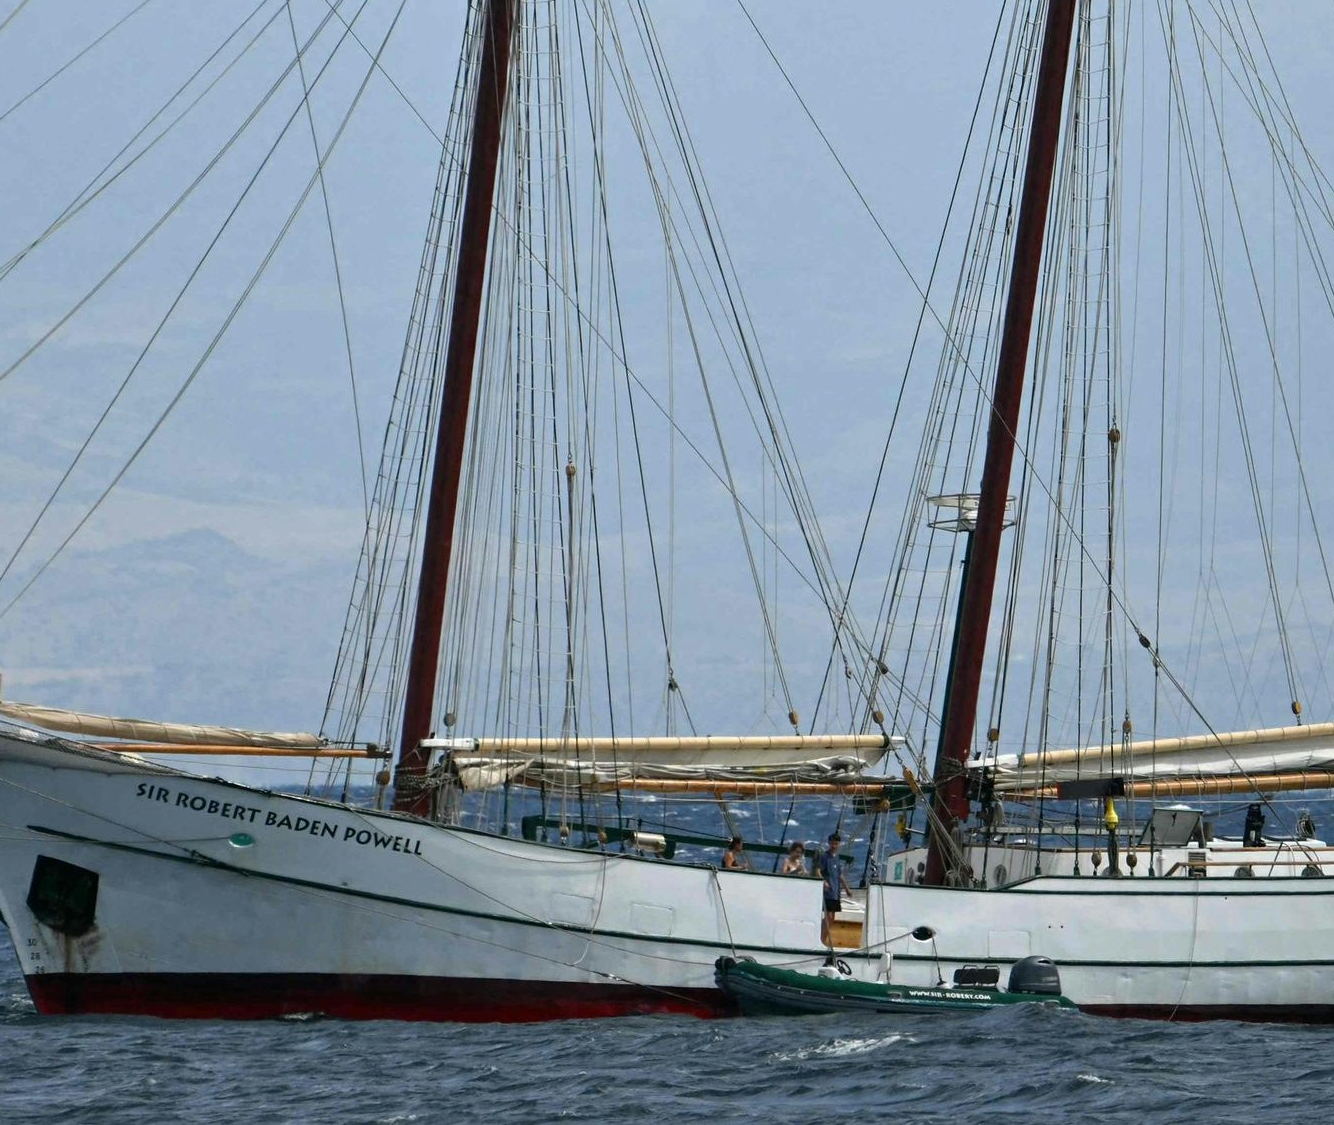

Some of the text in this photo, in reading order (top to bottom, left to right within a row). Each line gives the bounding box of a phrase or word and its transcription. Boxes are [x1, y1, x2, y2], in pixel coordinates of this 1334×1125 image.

[136, 783, 422, 855] SIR ROBERT BADEN POWELL
[27, 939, 36, 947] 30
